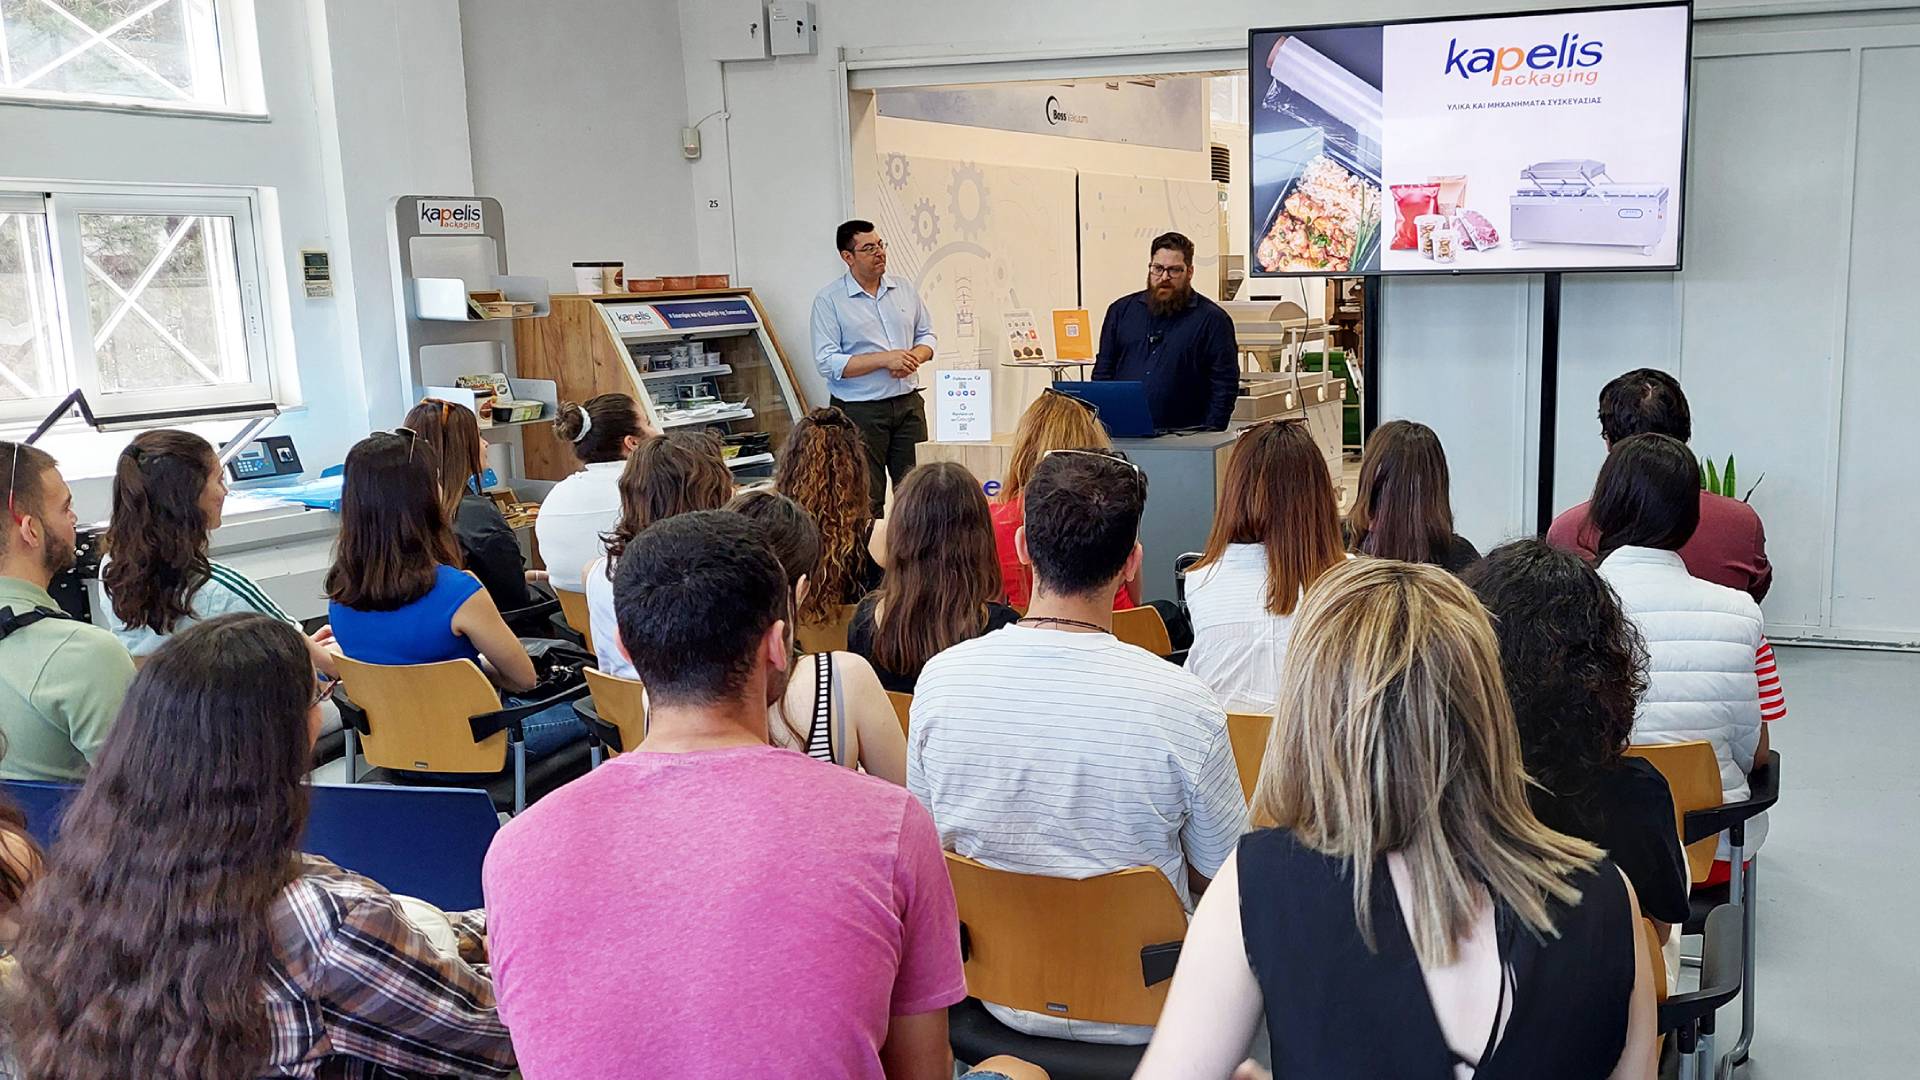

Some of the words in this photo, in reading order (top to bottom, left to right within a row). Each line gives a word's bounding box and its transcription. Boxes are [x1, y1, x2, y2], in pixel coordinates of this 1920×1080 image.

[1445, 32, 1604, 87] kapelis
[1447, 103, 1471, 111] ΥΛΙΚΑ
[1487, 100, 1546, 109] ΜΗΧΑΝΗΜΑΤΑ
[1053, 109, 1067, 121] Boss
[708, 199, 719, 208] 25
[421, 202, 481, 227] kapelis
[615, 310, 652, 324] kapelis
